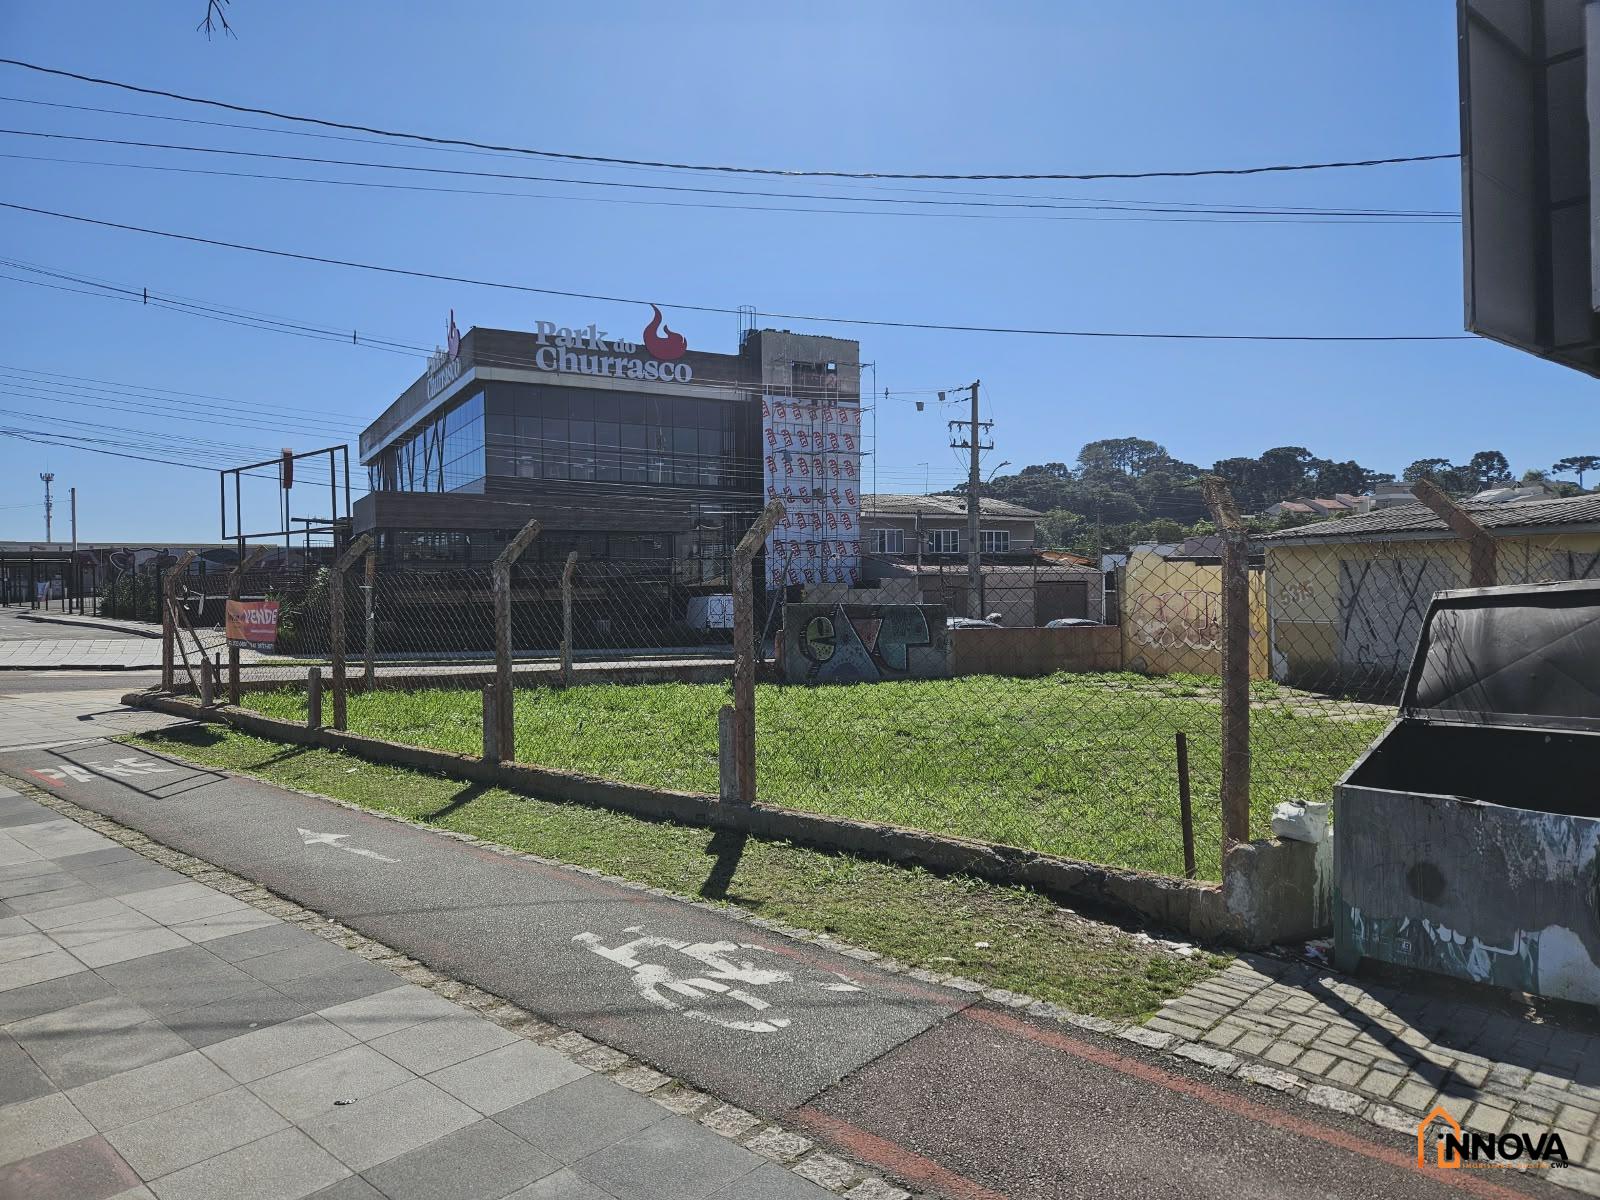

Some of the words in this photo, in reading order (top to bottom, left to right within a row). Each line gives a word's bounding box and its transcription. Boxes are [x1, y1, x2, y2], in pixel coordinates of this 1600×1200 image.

[535, 320, 609, 351] Park
[613, 337, 637, 354] do
[535, 346, 693, 383] Churrasco
[243, 609, 278, 624] VENDE
